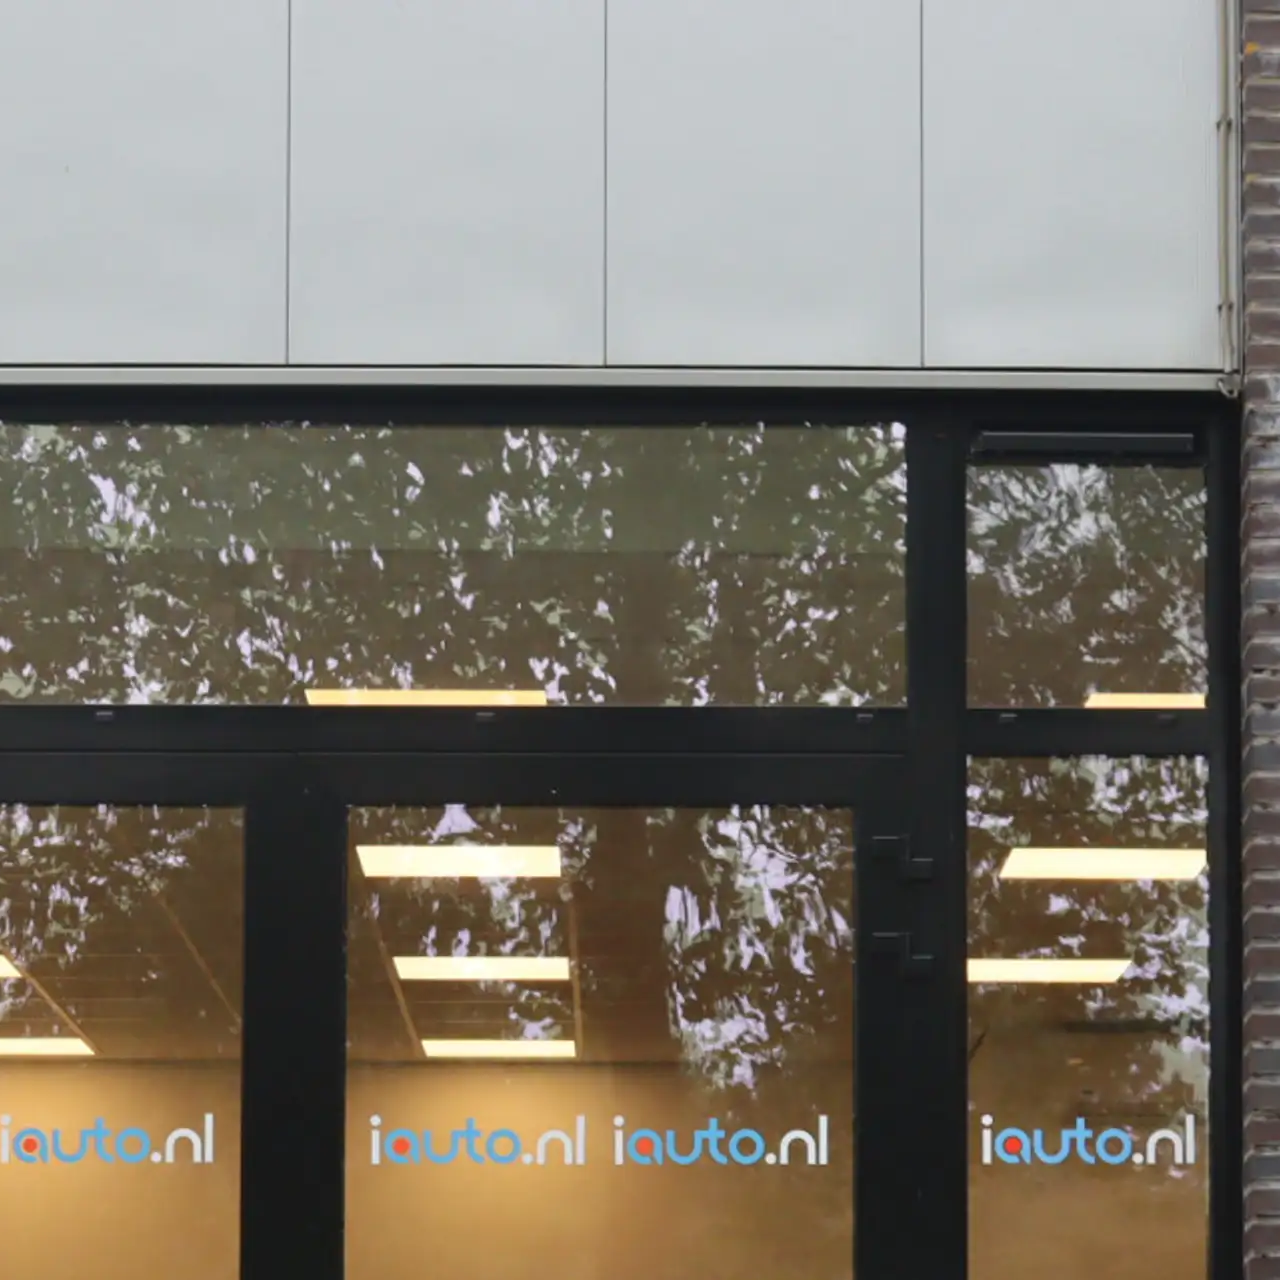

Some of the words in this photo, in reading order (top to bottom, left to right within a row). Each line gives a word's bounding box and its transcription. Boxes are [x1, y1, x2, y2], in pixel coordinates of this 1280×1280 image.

[0, 1113, 214, 1164] iauto.nl
[369, 1114, 586, 1166] iauto.nl
[613, 1114, 828, 1166] iauto.nl
[981, 1113, 1196, 1166] iauto.nl
